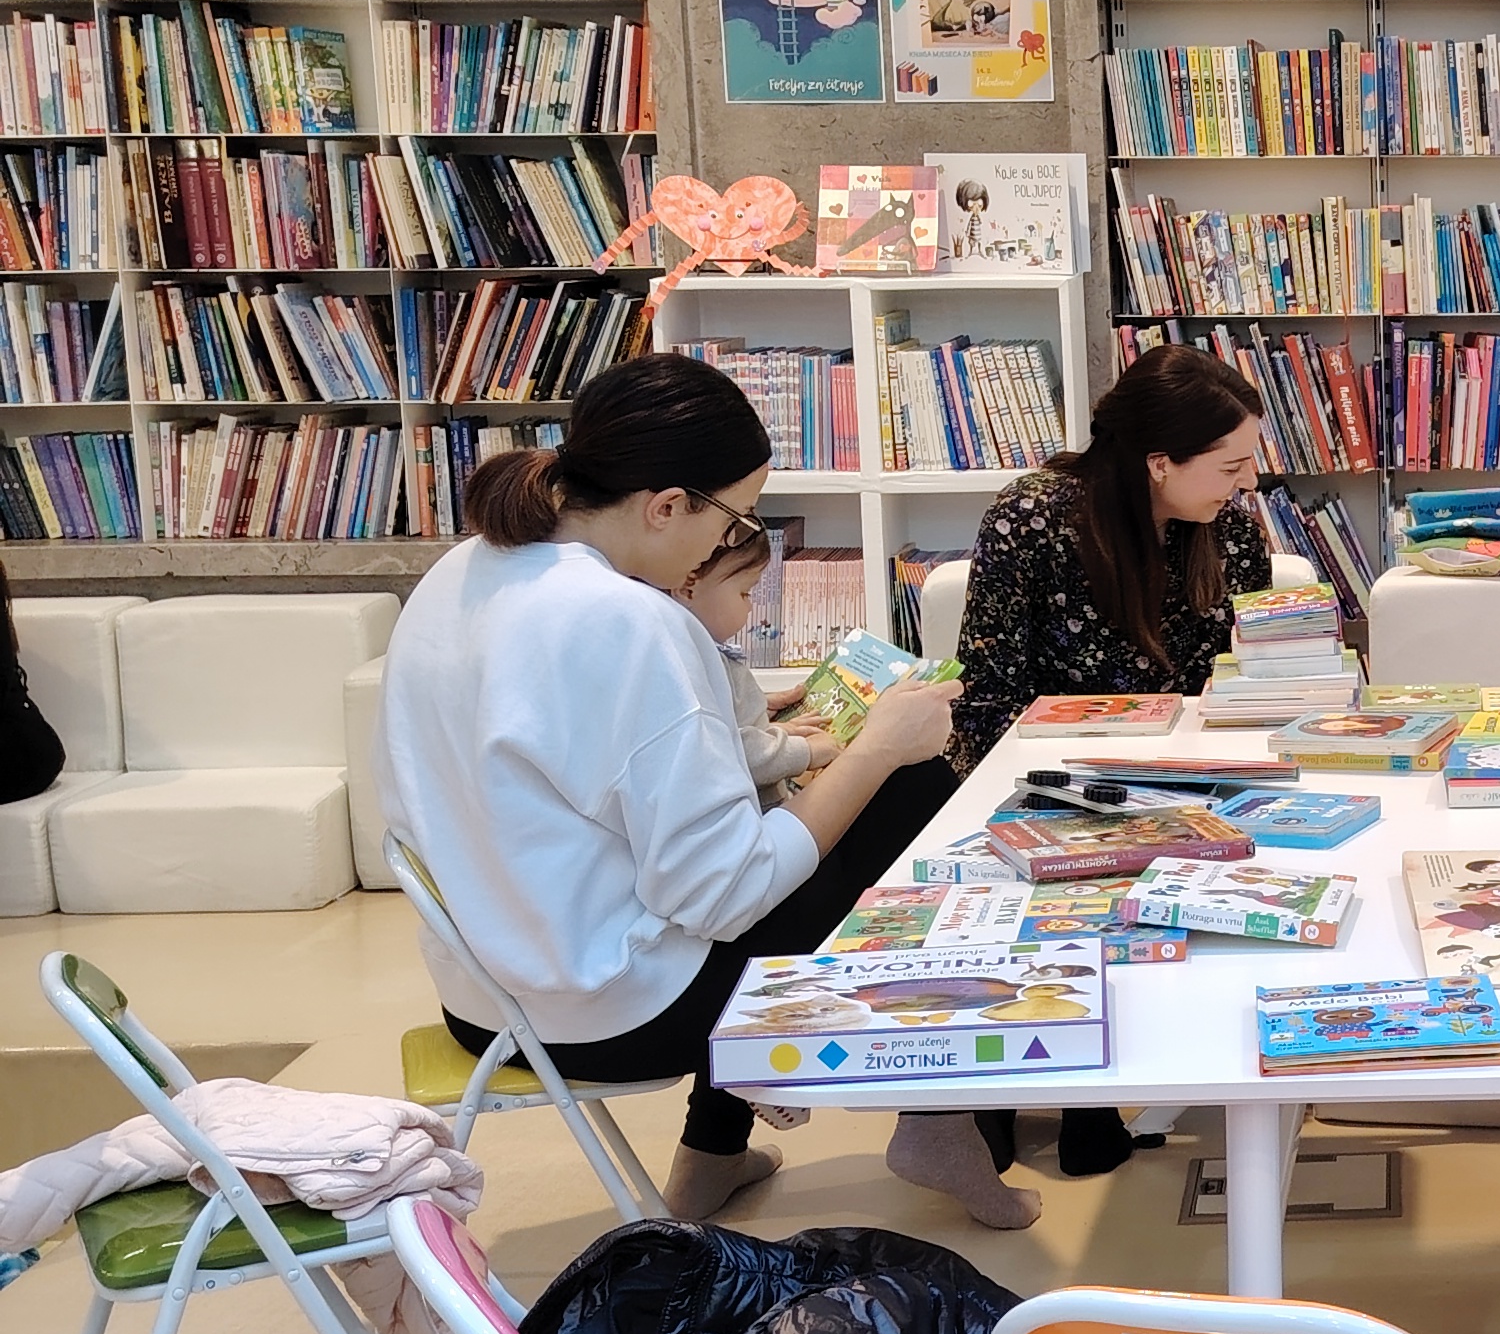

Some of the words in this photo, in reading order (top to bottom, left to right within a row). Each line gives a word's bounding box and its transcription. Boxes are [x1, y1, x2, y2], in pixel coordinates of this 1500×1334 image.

[769, 78, 806, 96] Fotelja
[808, 80, 824, 90] za
[826, 77, 864, 96] čitanje
[1022, 168, 1033, 179] su
[1038, 165, 1060, 178] BOJE
[1014, 185, 1062, 199] POLJUPCI?
[352, 188, 361, 234] KON-TIKI
[1339, 386, 1356, 424] Najljepše
[1348, 426, 1360, 446] priče
[1322, 755, 1343, 765] mali
[1344, 755, 1385, 765] dinosaur
[967, 868, 979, 877] Na
[1148, 881, 1189, 897] Pip
[938, 912, 970, 932] Moje
[956, 896, 975, 913] prve
[994, 896, 1024, 926] BAJKE
[1181, 911, 1215, 925] Potraga
[1226, 918, 1243, 927] vrtu
[894, 951, 927, 960] prvo
[937, 948, 987, 958] učenje
[816, 955, 1035, 975] ŽIVOTINJE
[950, 967, 999, 975] učenje
[1288, 997, 1349, 1008] Medo
[1358, 993, 1403, 1004] Bobi
[891, 1039, 915, 1051] prvo
[918, 1037, 951, 1049] učenje
[864, 1052, 958, 1070] ŽIVOTINJE
